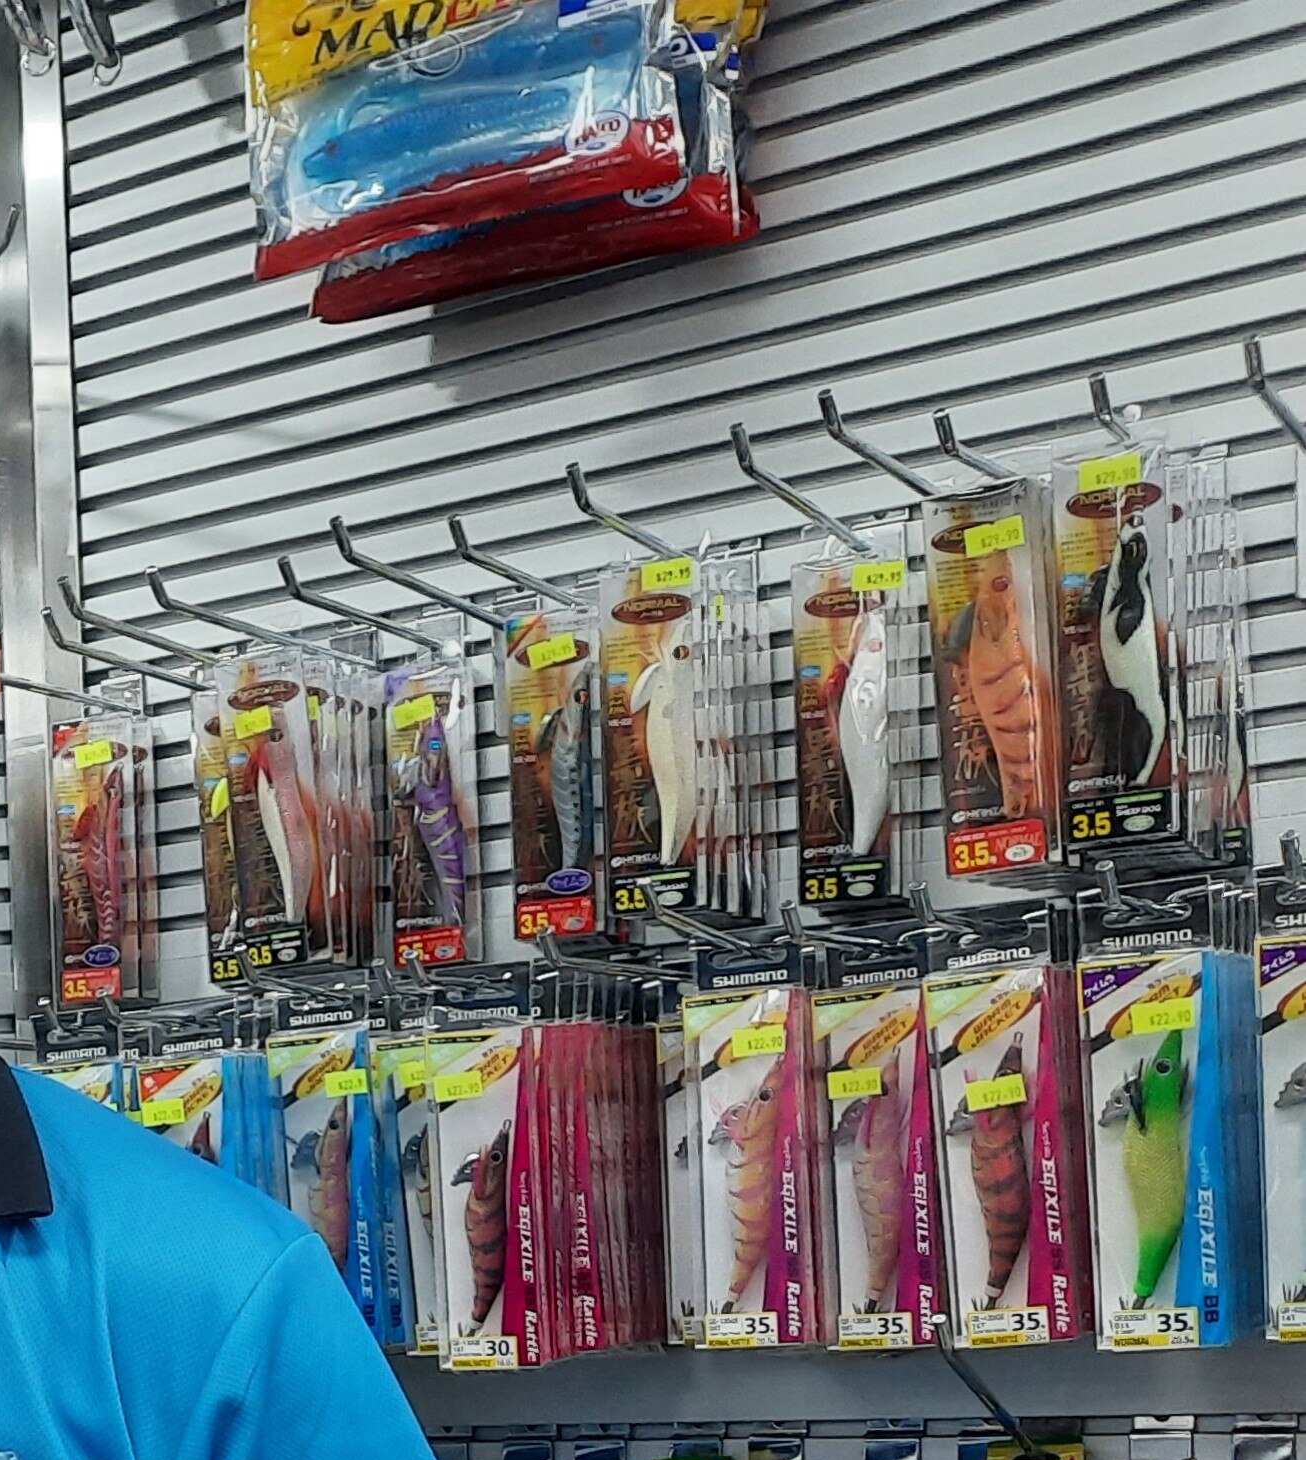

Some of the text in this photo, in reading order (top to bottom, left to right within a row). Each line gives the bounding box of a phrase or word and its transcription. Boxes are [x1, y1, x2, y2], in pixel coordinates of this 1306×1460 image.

[1095, 469, 1138, 484] $29.90
[656, 567, 691, 583] $29.95
[866, 572, 902, 585] $29.95
[1142, 804, 1161, 814] DOG
[1072, 812, 1112, 839] 3.5
[954, 841, 991, 870] 3.5
[805, 877, 838, 900] 3.5
[519, 913, 548, 935] 3.5
[1102, 929, 1192, 948] SHIMANO
[248, 945, 273, 965] 3.5
[947, 947, 1032, 969] SHIMANO
[213, 959, 239, 979] 3.5
[712, 968, 788, 987] SHIMANO
[842, 967, 918, 986] SHIMANO
[64, 978, 88, 997] 3.5
[289, 1010, 353, 1026] SHIMANO
[447, 1005, 518, 1022] SHIMANO
[1149, 1010, 1191, 1025] $22.90
[162, 1037, 223, 1055] SHIMANO
[747, 1035, 783, 1050] $22.90
[46, 1045, 107, 1062] SHIMANO
[842, 1078, 878, 1092] $22.90
[982, 1085, 1022, 1104] $22.90
[1039, 1156, 1063, 1245] EGIXILE
[780, 1171, 798, 1254] EGIXILE
[910, 1172, 930, 1256] EGIXILE
[912, 1172, 930, 1255] EGIXILE
[519, 1205, 533, 1283] EGIXILE
[1192, 1188, 1218, 1289] EGIXILE
[358, 1218, 373, 1300] EGIXILE
[785, 1281, 801, 1337] Rattle
[919, 1284, 932, 1341] Rattle
[1051, 1273, 1068, 1333] Rattle
[582, 1294, 595, 1347] Rattle
[744, 1317, 770, 1335] 35
[877, 1317, 904, 1334] 35
[1011, 1312, 1041, 1331] 35
[1157, 1311, 1188, 1331] 35
[525, 1309, 538, 1362] Rattle
[485, 1340, 509, 1357] 30
